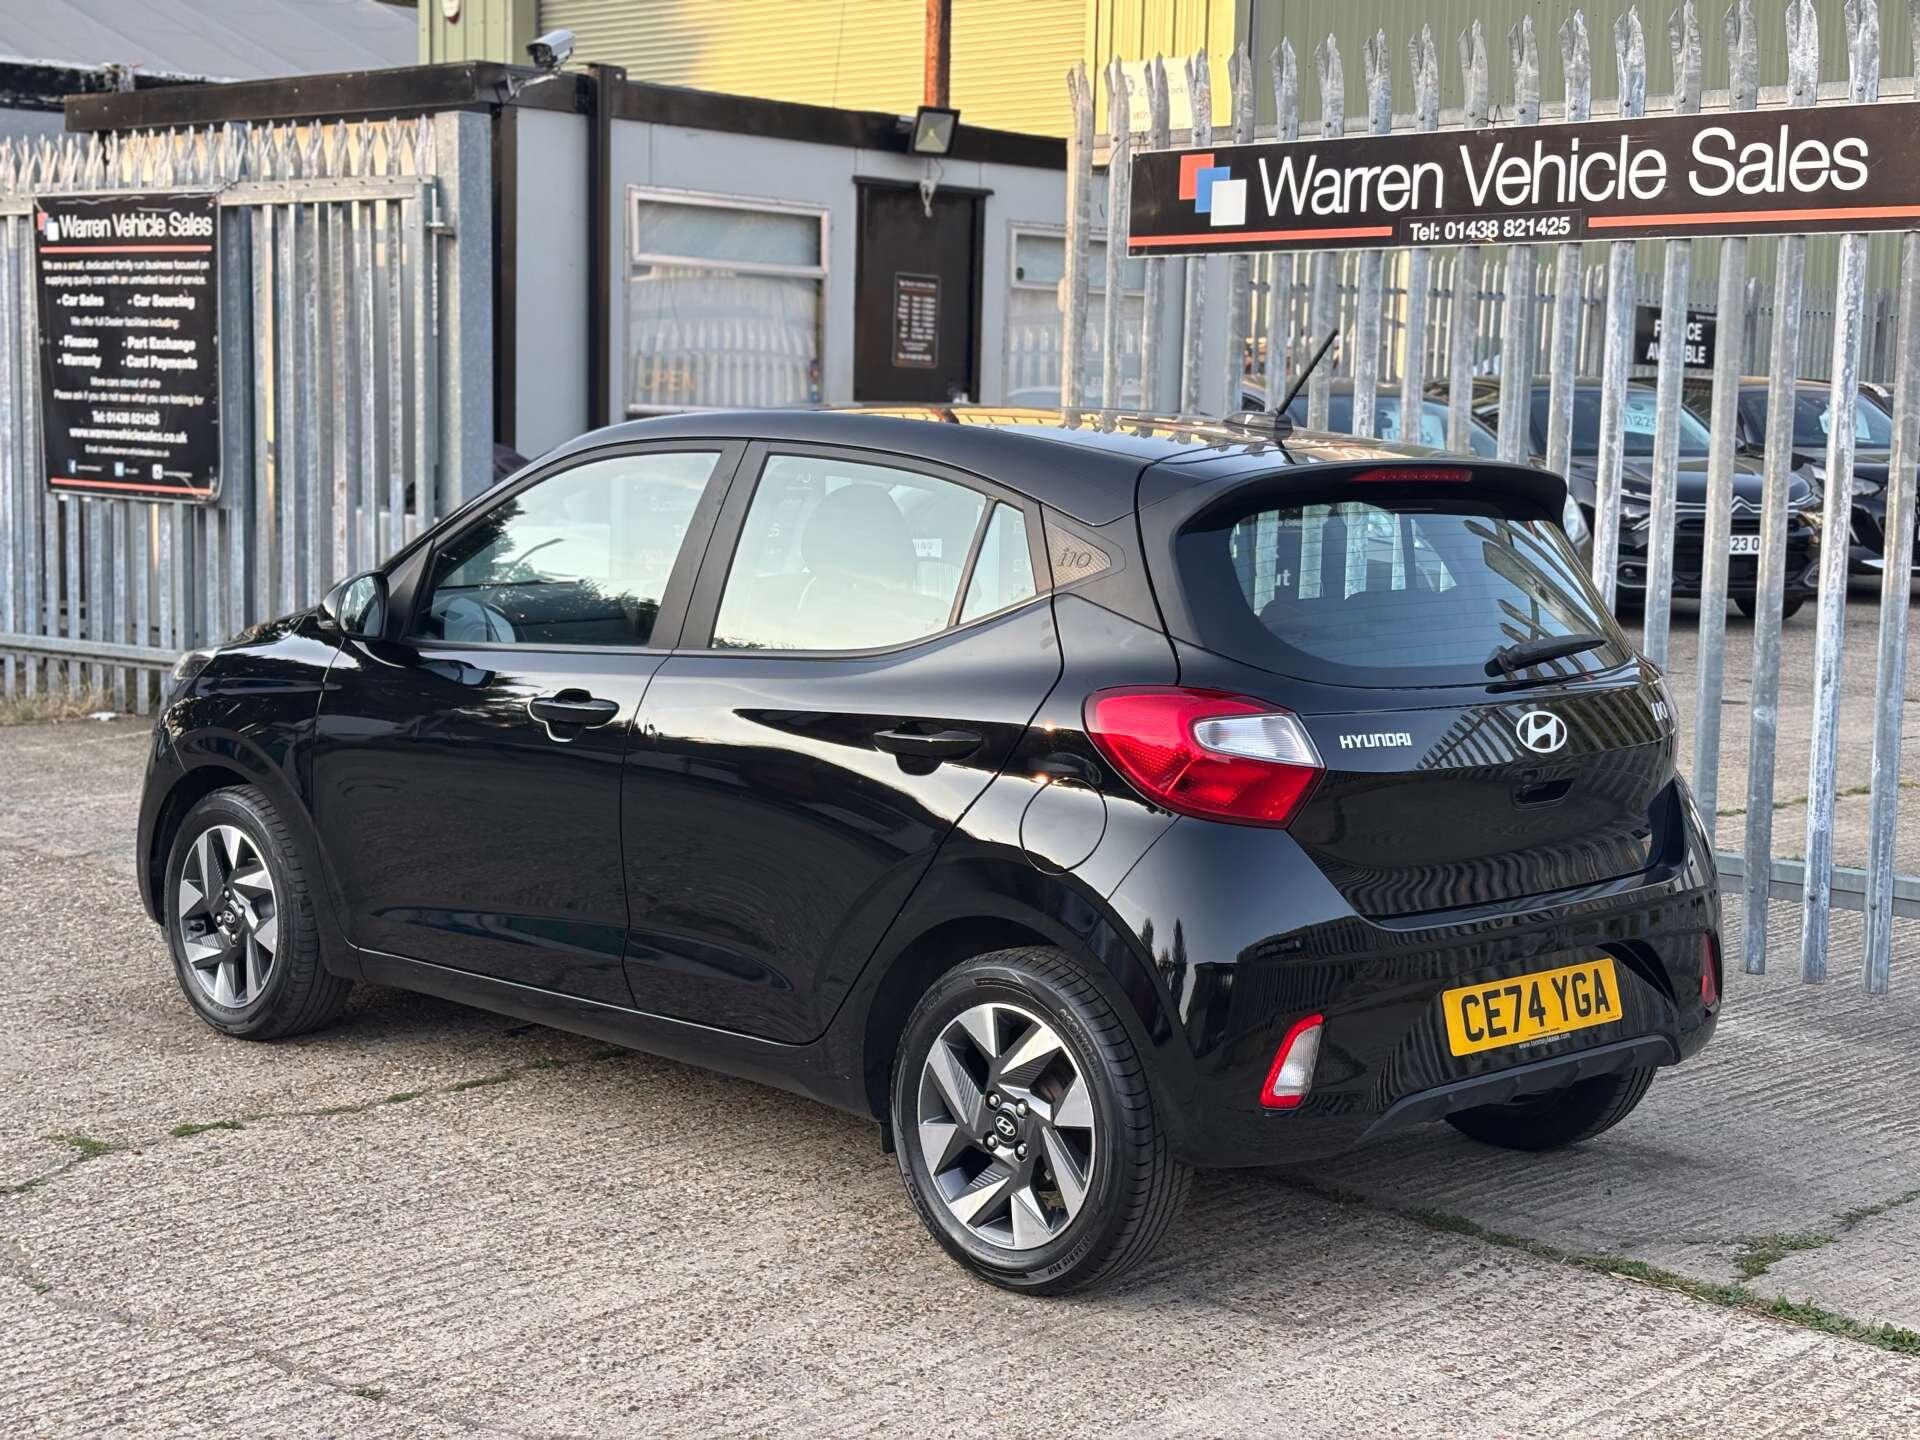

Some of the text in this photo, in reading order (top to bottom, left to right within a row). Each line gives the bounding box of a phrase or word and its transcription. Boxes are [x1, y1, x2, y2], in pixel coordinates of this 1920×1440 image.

[1258, 124, 1868, 217] Warren Vehicle Sales
[59, 210, 213, 238] Warren Vehicle Sales
[1410, 216, 1571, 241] Tel: 01438 821425
[61, 293, 104, 307] Car Sales
[133, 293, 196, 310] Car Sourcing
[64, 334, 99, 348] Finance
[127, 335, 196, 353] Part Exchange
[62, 353, 101, 369] Warranty
[126, 354, 198, 371] Card Payments
[1339, 732, 1412, 749] HYUNDAI
[1461, 968, 1611, 1042] CE74 YGA
